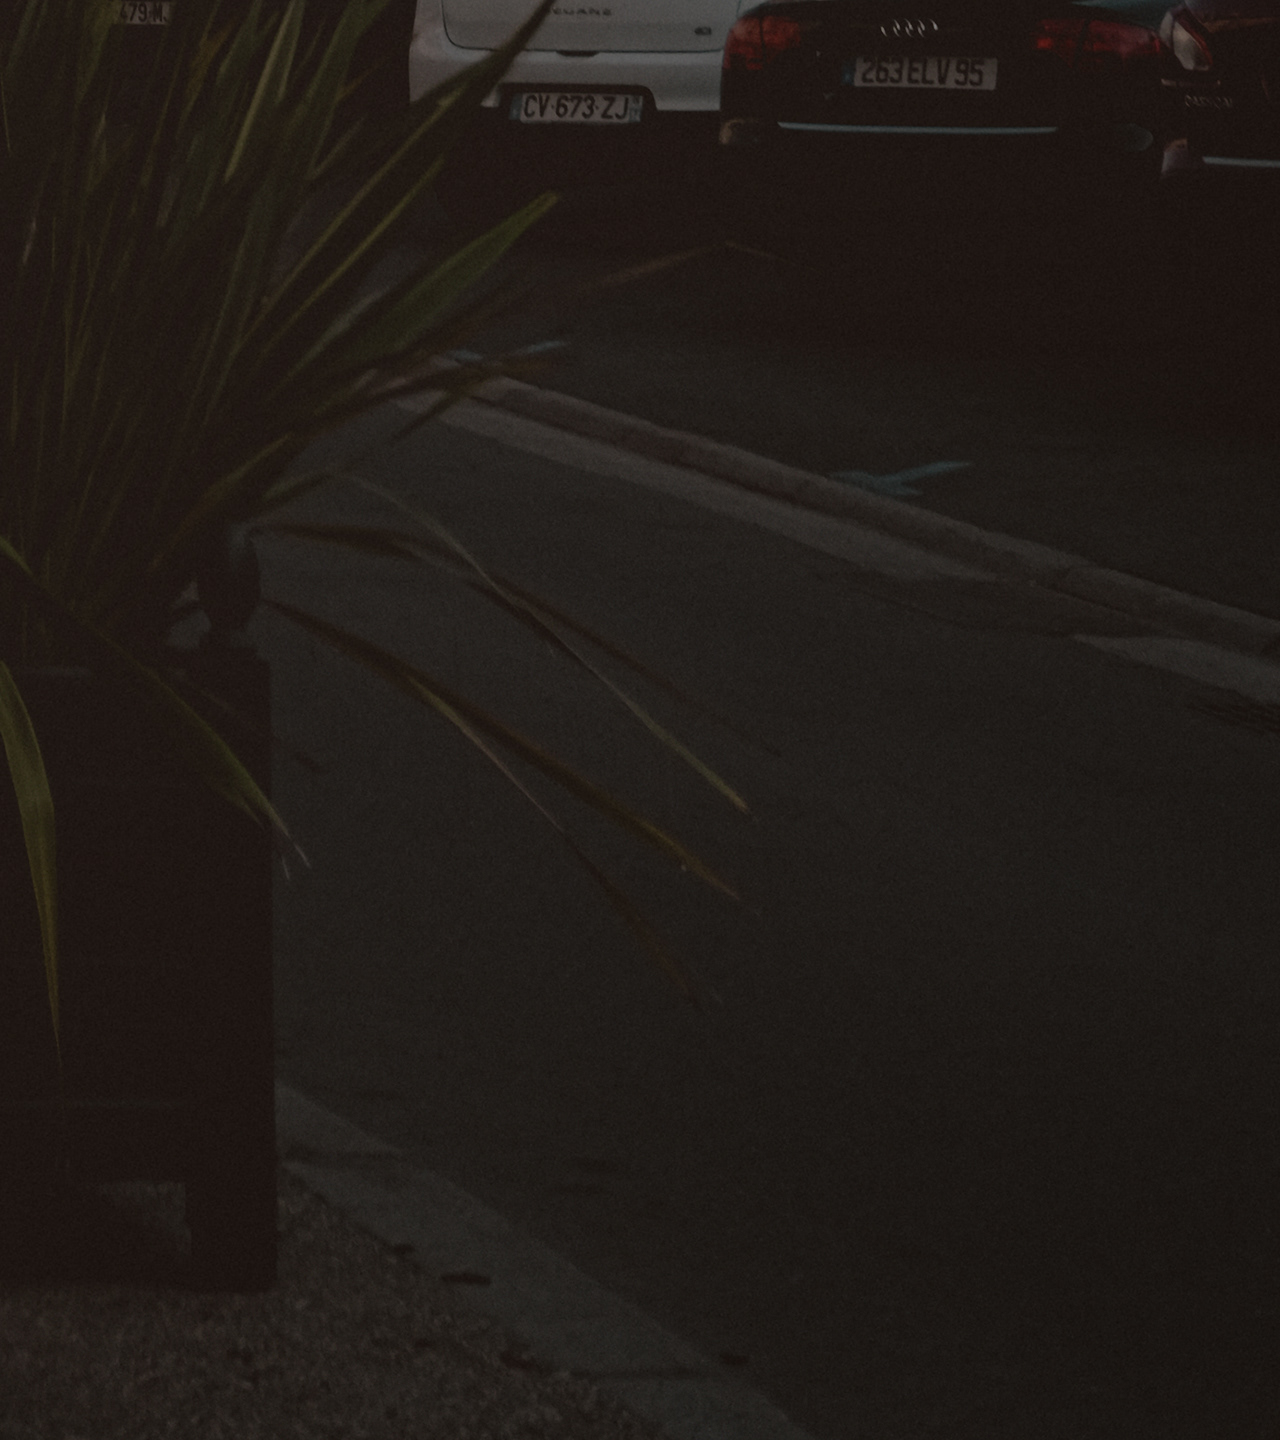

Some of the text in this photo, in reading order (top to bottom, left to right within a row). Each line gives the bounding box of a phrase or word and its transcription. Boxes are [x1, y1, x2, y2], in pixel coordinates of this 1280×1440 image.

[861, 56, 985, 87] 263 ELV 95
